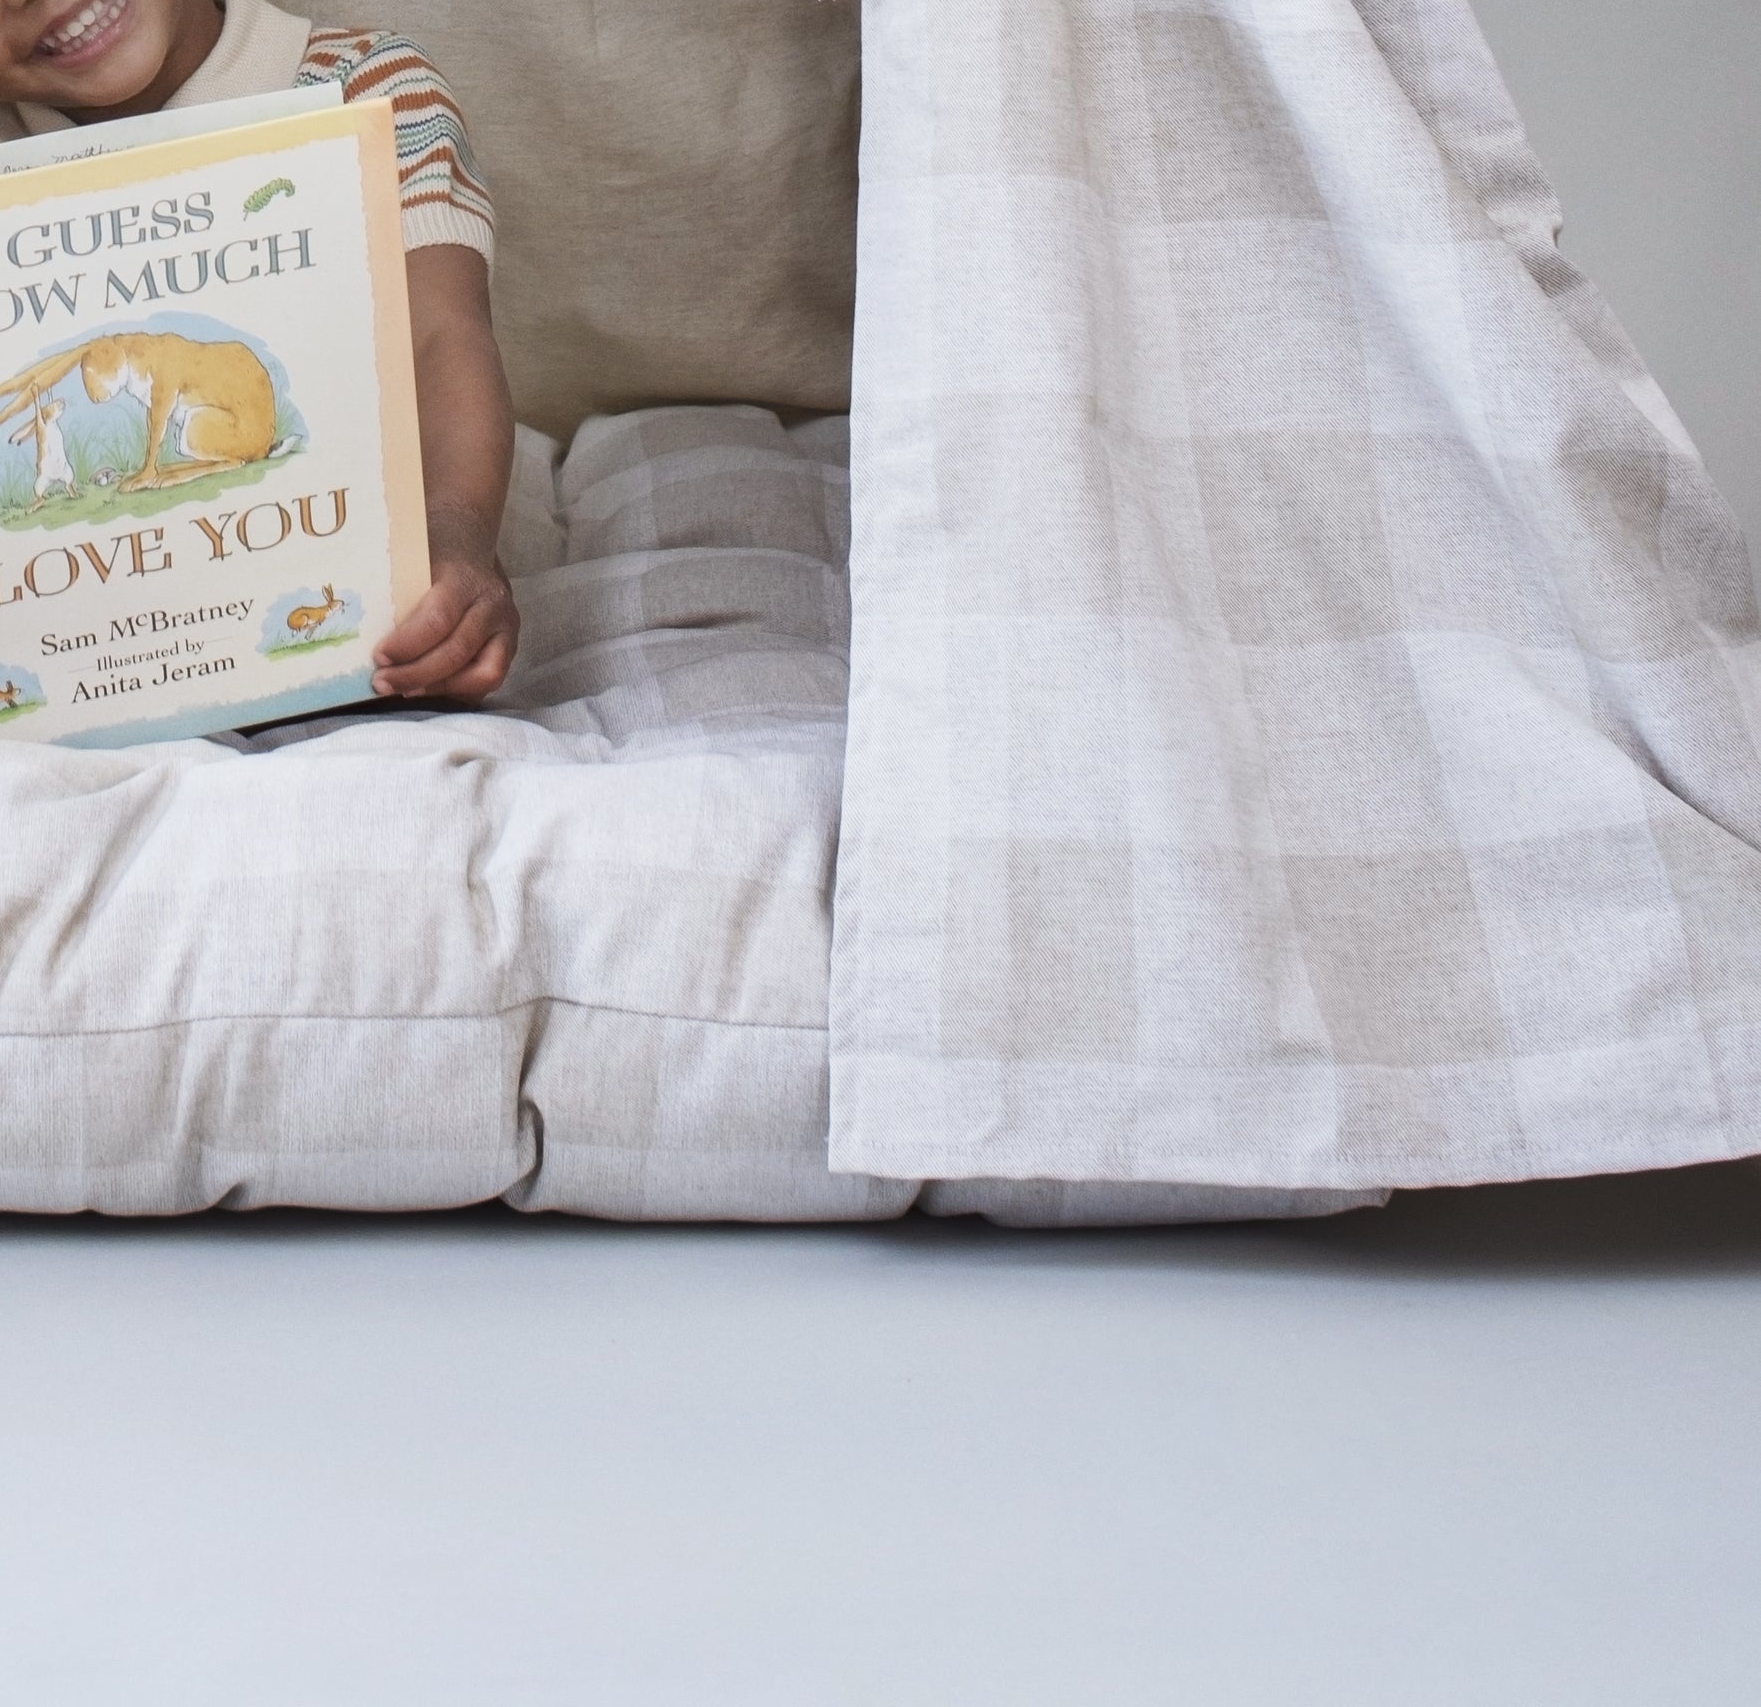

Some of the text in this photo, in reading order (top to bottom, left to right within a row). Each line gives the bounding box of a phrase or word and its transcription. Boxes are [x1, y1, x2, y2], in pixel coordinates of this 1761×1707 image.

[6, 191, 215, 269] GUESS
[103, 227, 317, 308] MUCH
[189, 487, 350, 561] YOU
[40, 598, 255, 657] Sam McBratney
[95, 637, 206, 673] Illustrated by
[71, 653, 237, 704] Anita Jeram
